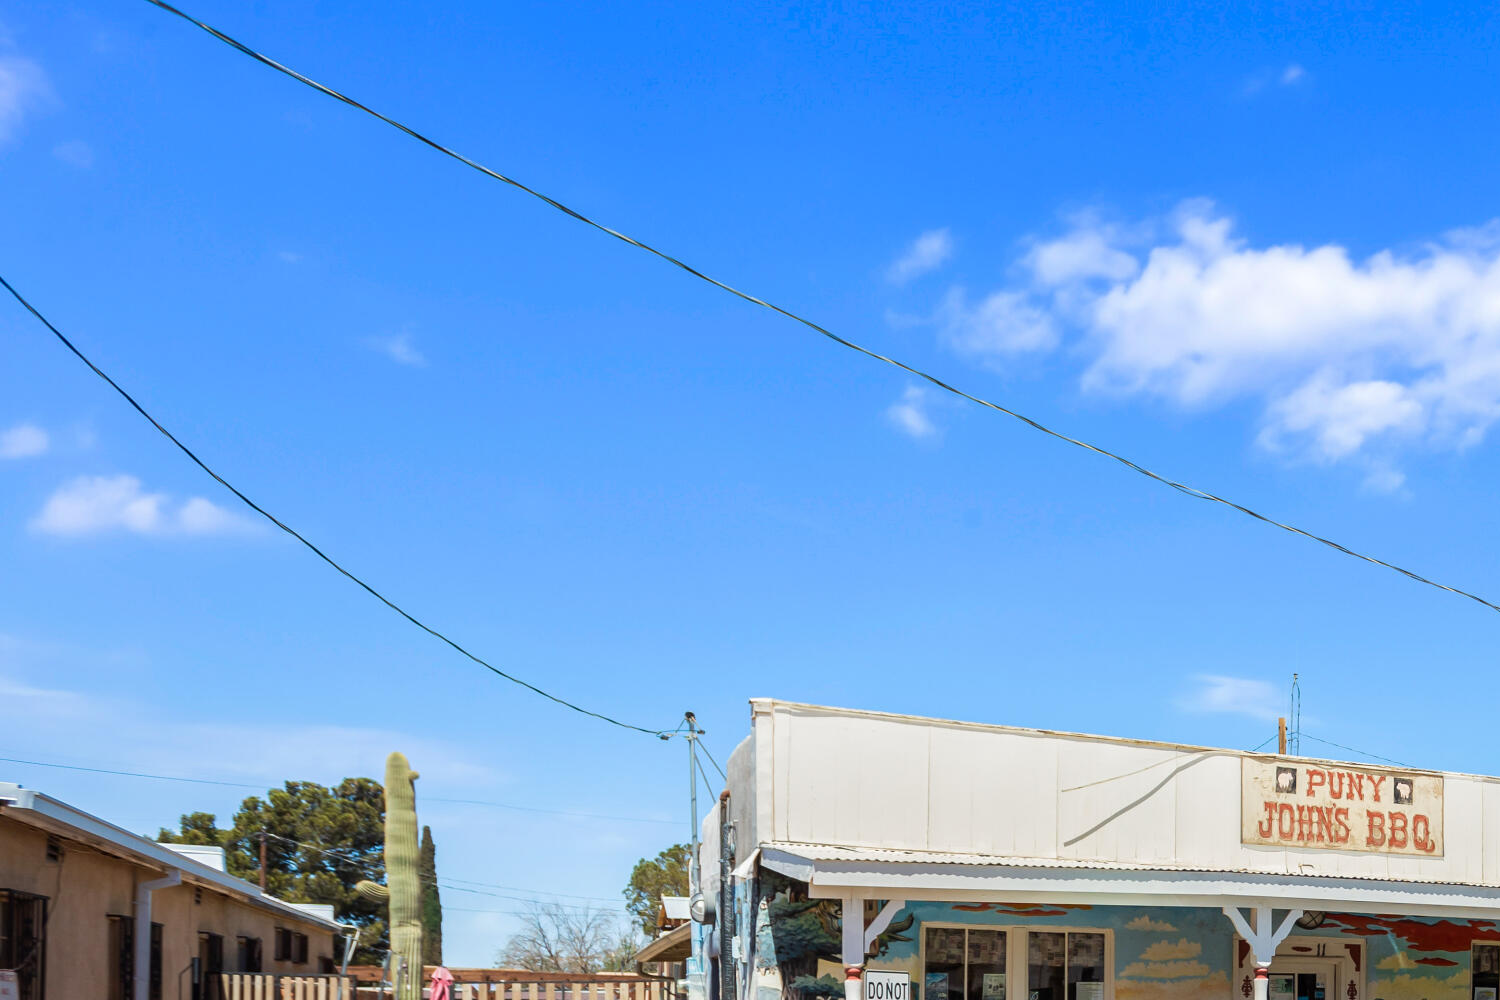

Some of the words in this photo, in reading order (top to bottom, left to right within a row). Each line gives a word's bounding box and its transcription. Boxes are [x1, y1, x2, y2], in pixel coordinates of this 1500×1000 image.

[1306, 769, 1386, 802] PUNY
[1258, 801, 1350, 844] JOHN'S
[1366, 809, 1435, 853] BBQ
[1317, 943, 1325, 957] 11
[868, 982, 883, 1000] DO
[886, 982, 907, 1000] NOT
